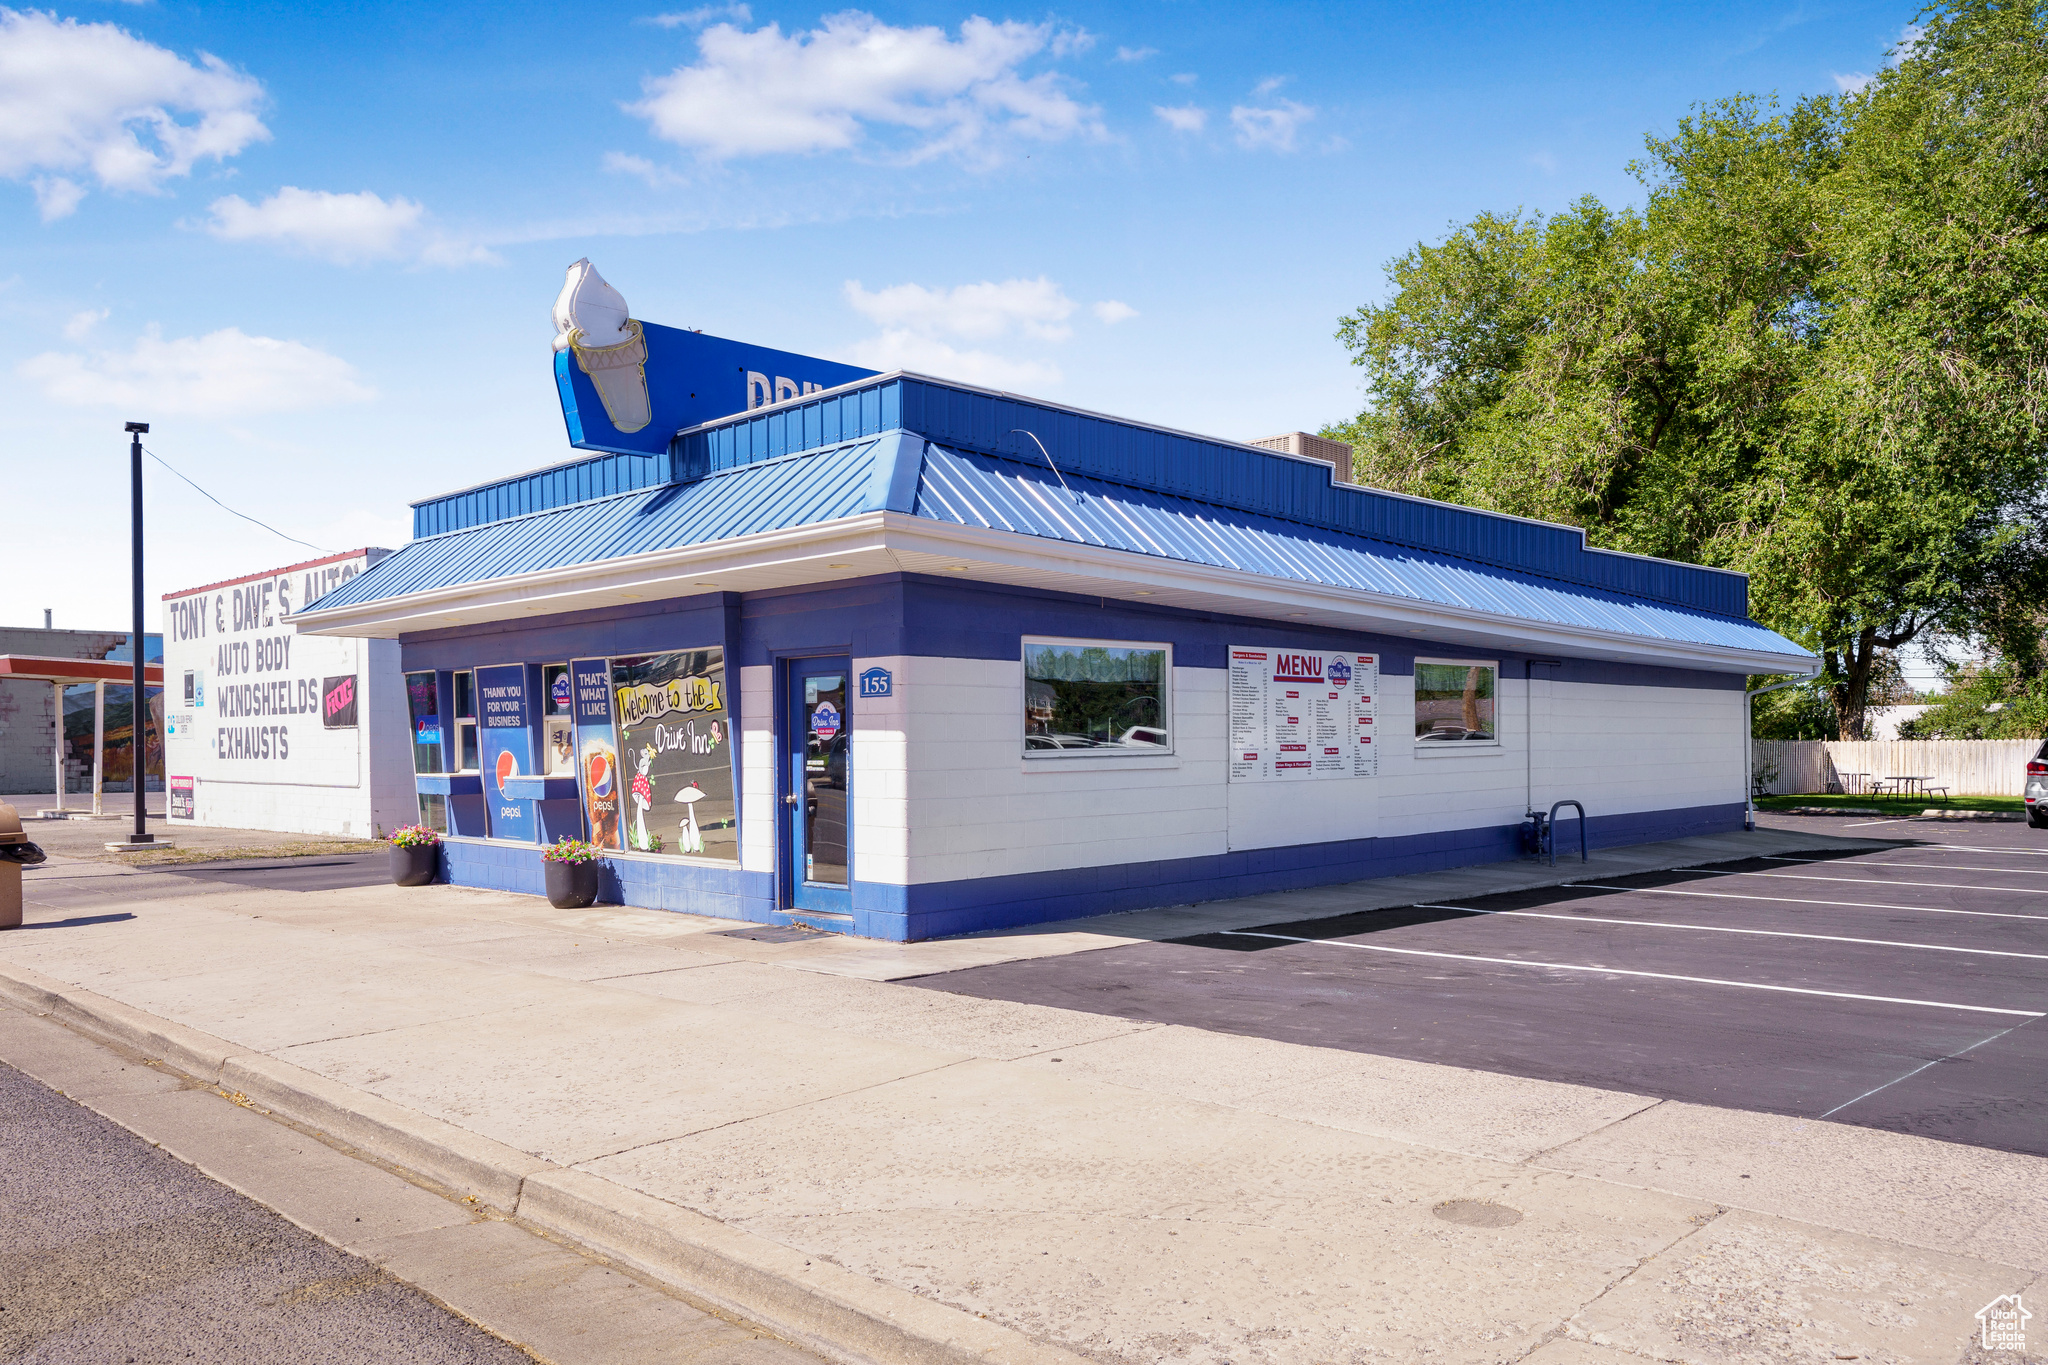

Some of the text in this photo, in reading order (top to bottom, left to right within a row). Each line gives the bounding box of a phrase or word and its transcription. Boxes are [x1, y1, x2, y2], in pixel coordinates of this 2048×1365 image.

[748, 370, 822, 410] DR
[171, 596, 207, 642] TONY
[216, 594, 225, 633] &
[233, 576, 290, 632] DAVE'S
[218, 635, 290, 677] AUTO BODY
[1277, 654, 1322, 676] MENU
[1329, 667, 1342, 677] Drive
[578, 672, 608, 686] THAT'S
[863, 676, 888, 693] 155
[218, 678, 318, 718] WINDSHIELDS
[483, 686, 521, 698] THANK YOU
[580, 688, 606, 701] WHAT
[487, 701, 519, 712] FOR YOUR
[620, 680, 705, 722] Welcome to the
[581, 702, 606, 715] I LIKE
[488, 716, 520, 727] BUSINESS
[812, 715, 840, 727] Drive Inn
[218, 726, 288, 760] EXHAUSTS
[655, 719, 711, 754] Drive Inn
[501, 805, 521, 819] pepsi
[593, 799, 615, 813] pepsi
